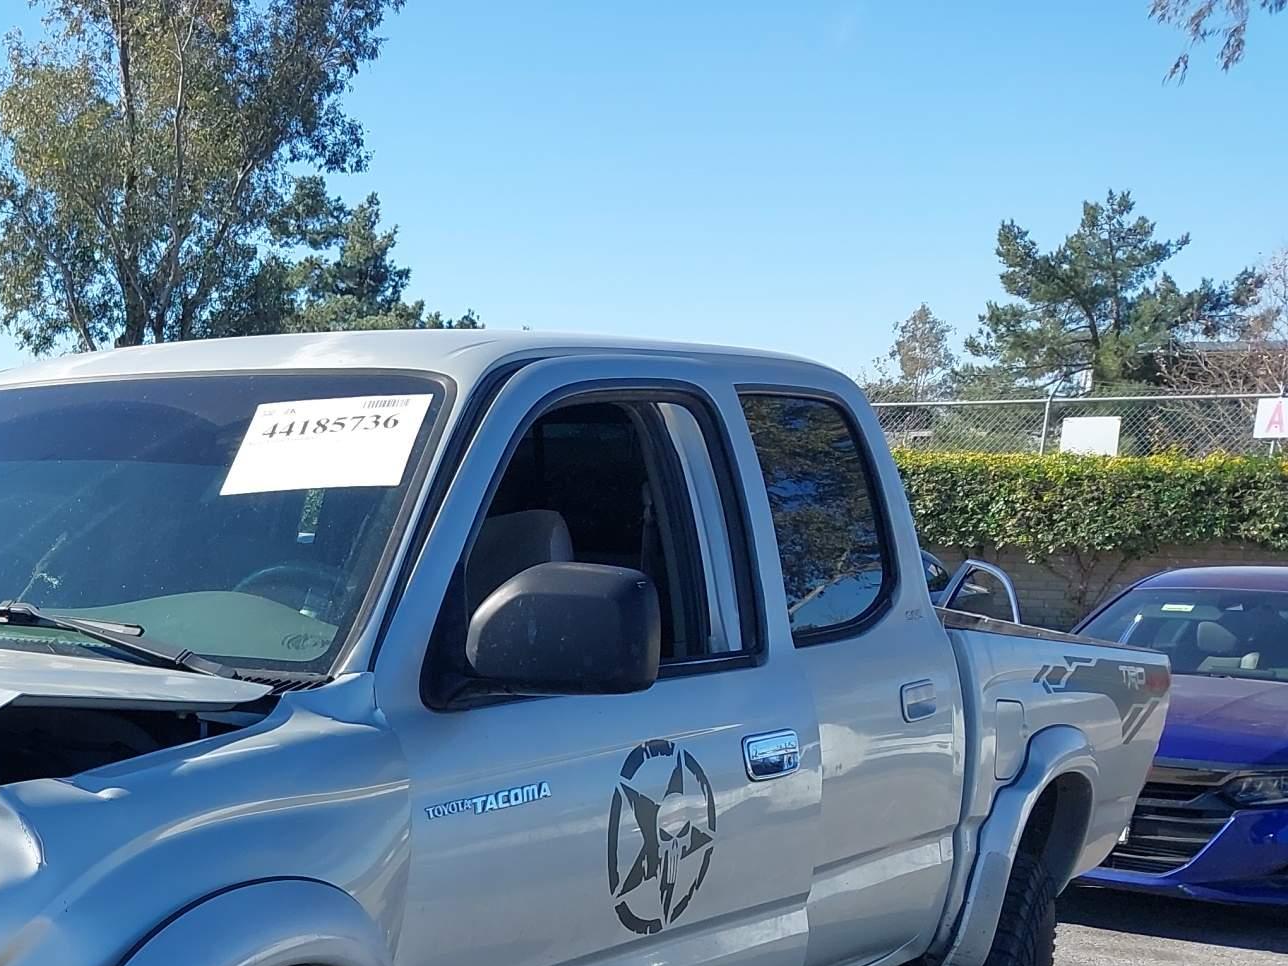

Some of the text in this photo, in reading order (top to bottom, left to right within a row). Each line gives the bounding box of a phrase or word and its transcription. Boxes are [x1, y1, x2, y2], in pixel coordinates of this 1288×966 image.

[261, 413, 400, 439] 44185736
[1118, 664, 1147, 691] TRD
[425, 781, 552, 819] TOYOTA TACOMA
